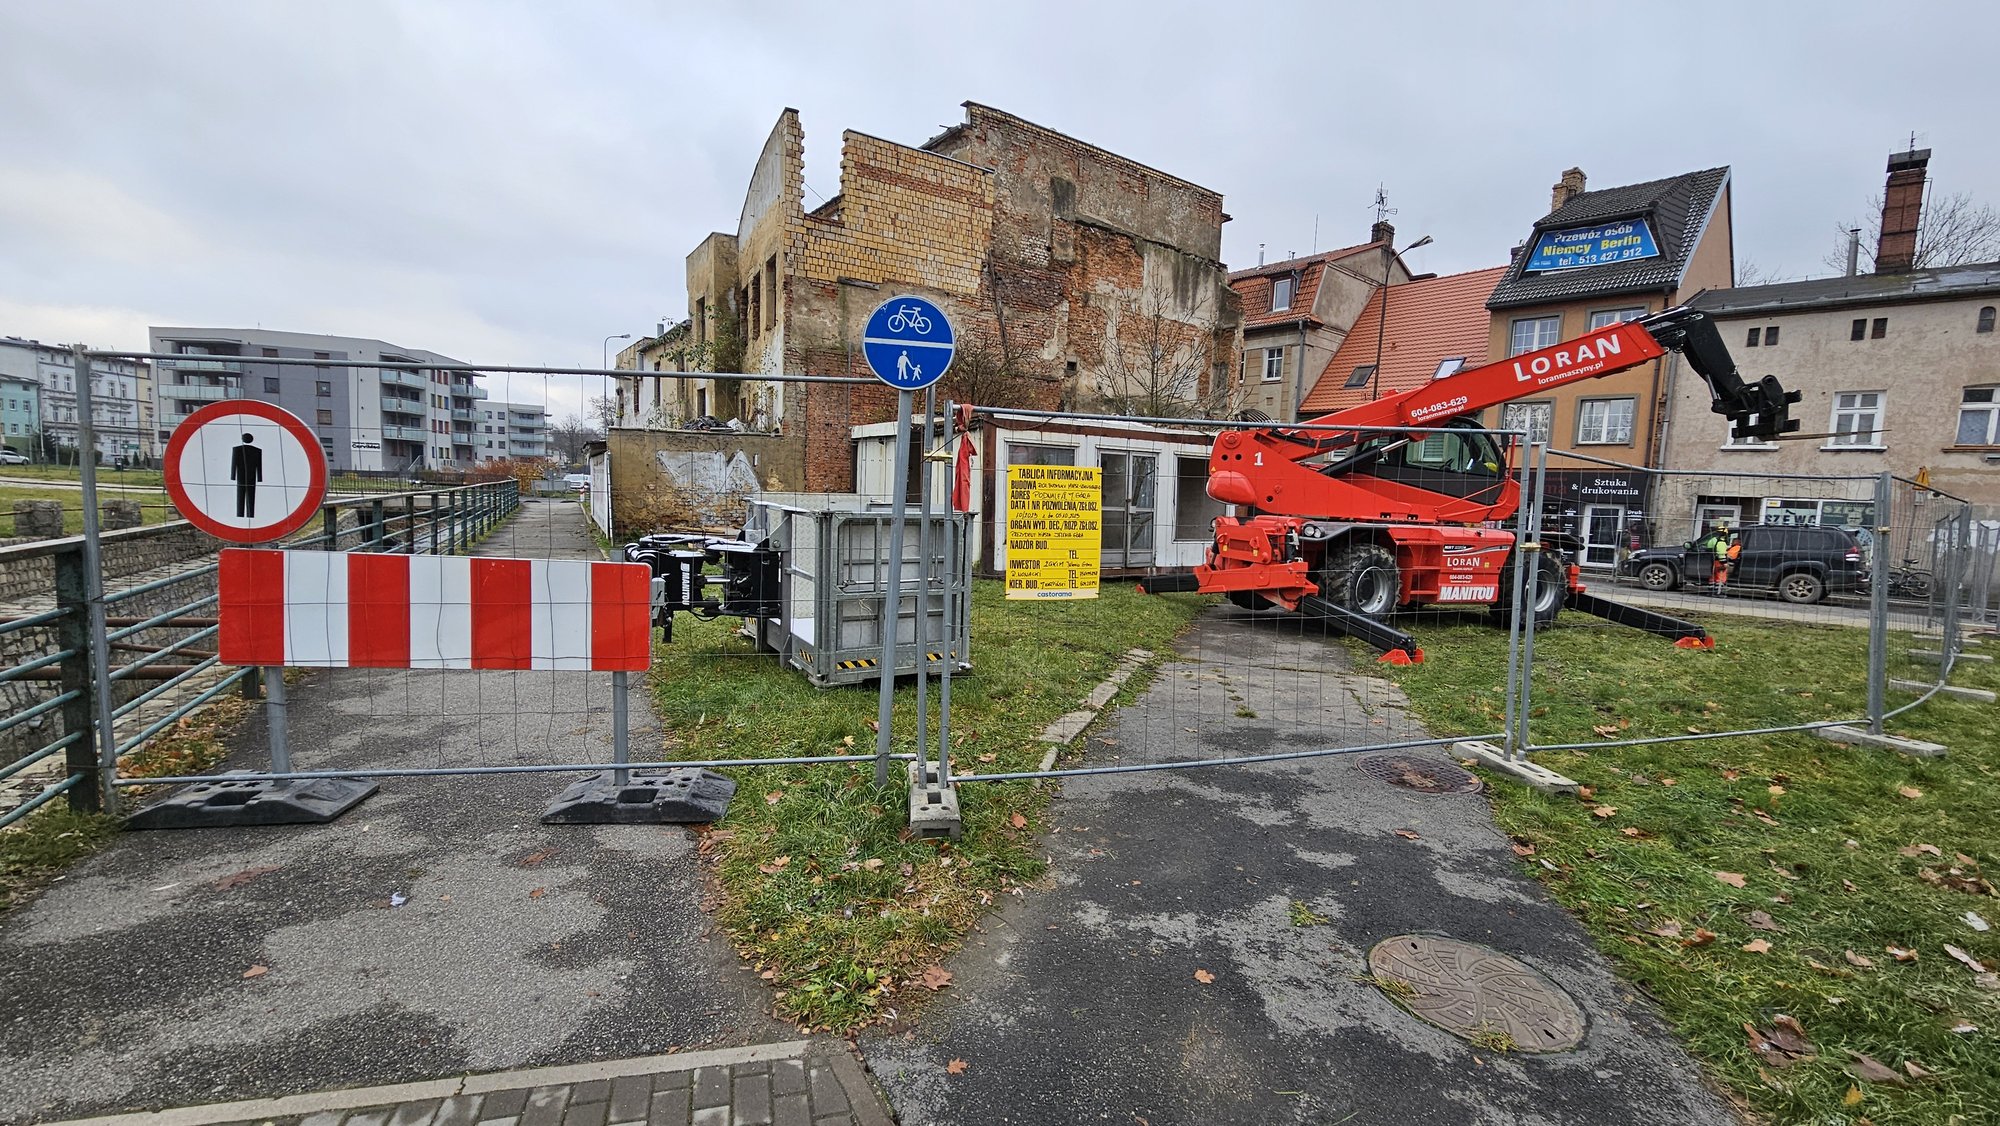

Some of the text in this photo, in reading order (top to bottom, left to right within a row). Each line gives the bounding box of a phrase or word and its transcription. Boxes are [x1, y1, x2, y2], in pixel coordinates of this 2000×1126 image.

[1554, 225, 1633, 243] Przewóz osób
[1543, 235, 1642, 257] Niemcy Berlin
[1559, 257, 1574, 266] tel.
[1579, 255, 1597, 264] 513
[1600, 252, 1619, 262] 427
[1623, 247, 1642, 257] 912
[1513, 334, 1621, 382] LORAN
[1538, 361, 1604, 385] loranmaszyny.pl
[1411, 396, 1468, 418] 604-083-629
[1254, 452, 1264, 466] 1
[1018, 468, 1094, 481] TABLICA INFORMACYJNA
[1011, 480, 1037, 490] BUDOWA
[1594, 478, 1627, 487] Sztuka
[1011, 490, 1030, 500] ADRES
[1582, 486, 1639, 496] drukowania
[1011, 500, 1025, 510] DATA
[1027, 500, 1030, 510] I
[1031, 501, 1040, 510] NR
[1010, 520, 1031, 530] ORGAN
[1033, 520, 1048, 530] WYD.
[1010, 539, 1049, 550] NADZÓR BUD.
[1069, 550, 1079, 559] TEL.
[1009, 560, 1041, 569] INWESTOR
[1447, 557, 1480, 567] LORAN
[1068, 570, 1079, 579] TEL.
[682, 572, 690, 605] MANITOU
[1009, 580, 1025, 589] KIER.
[1025, 580, 1040, 589] BUD.
[1068, 580, 1079, 588] TEL.
[1440, 587, 1494, 600] MANITOU
